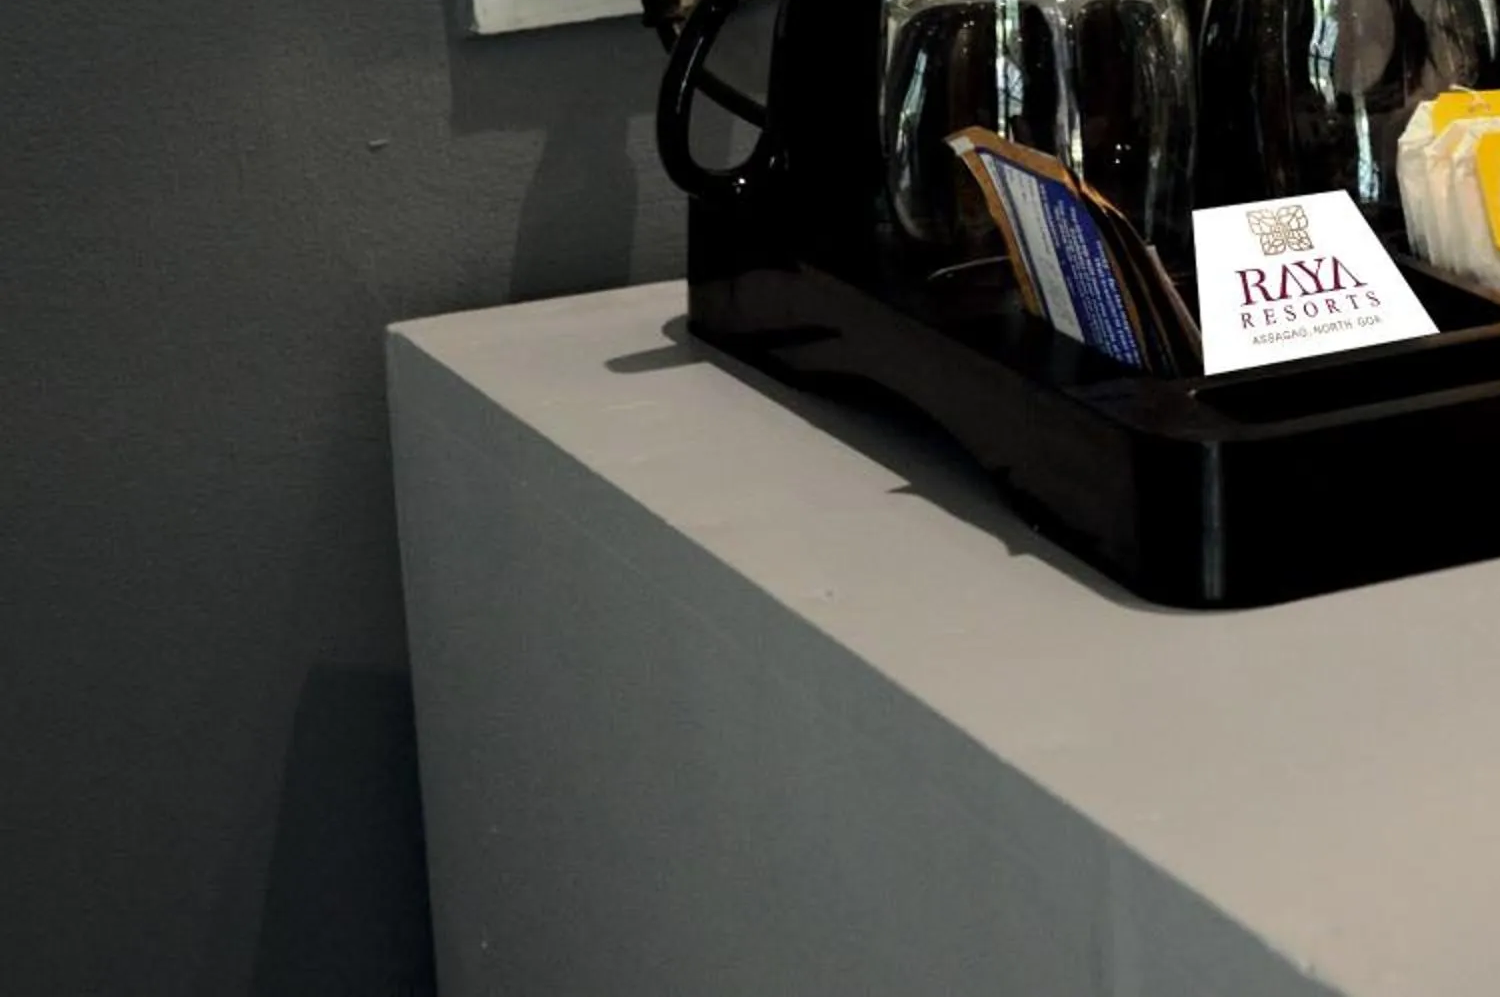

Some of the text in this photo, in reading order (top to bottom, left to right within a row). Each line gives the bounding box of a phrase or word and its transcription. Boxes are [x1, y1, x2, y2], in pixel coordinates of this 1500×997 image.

[1235, 255, 1368, 306] RAYA
[1241, 290, 1382, 329] RESORTS
[1313, 320, 1353, 334] NORTH
[1357, 315, 1381, 328] GOA
